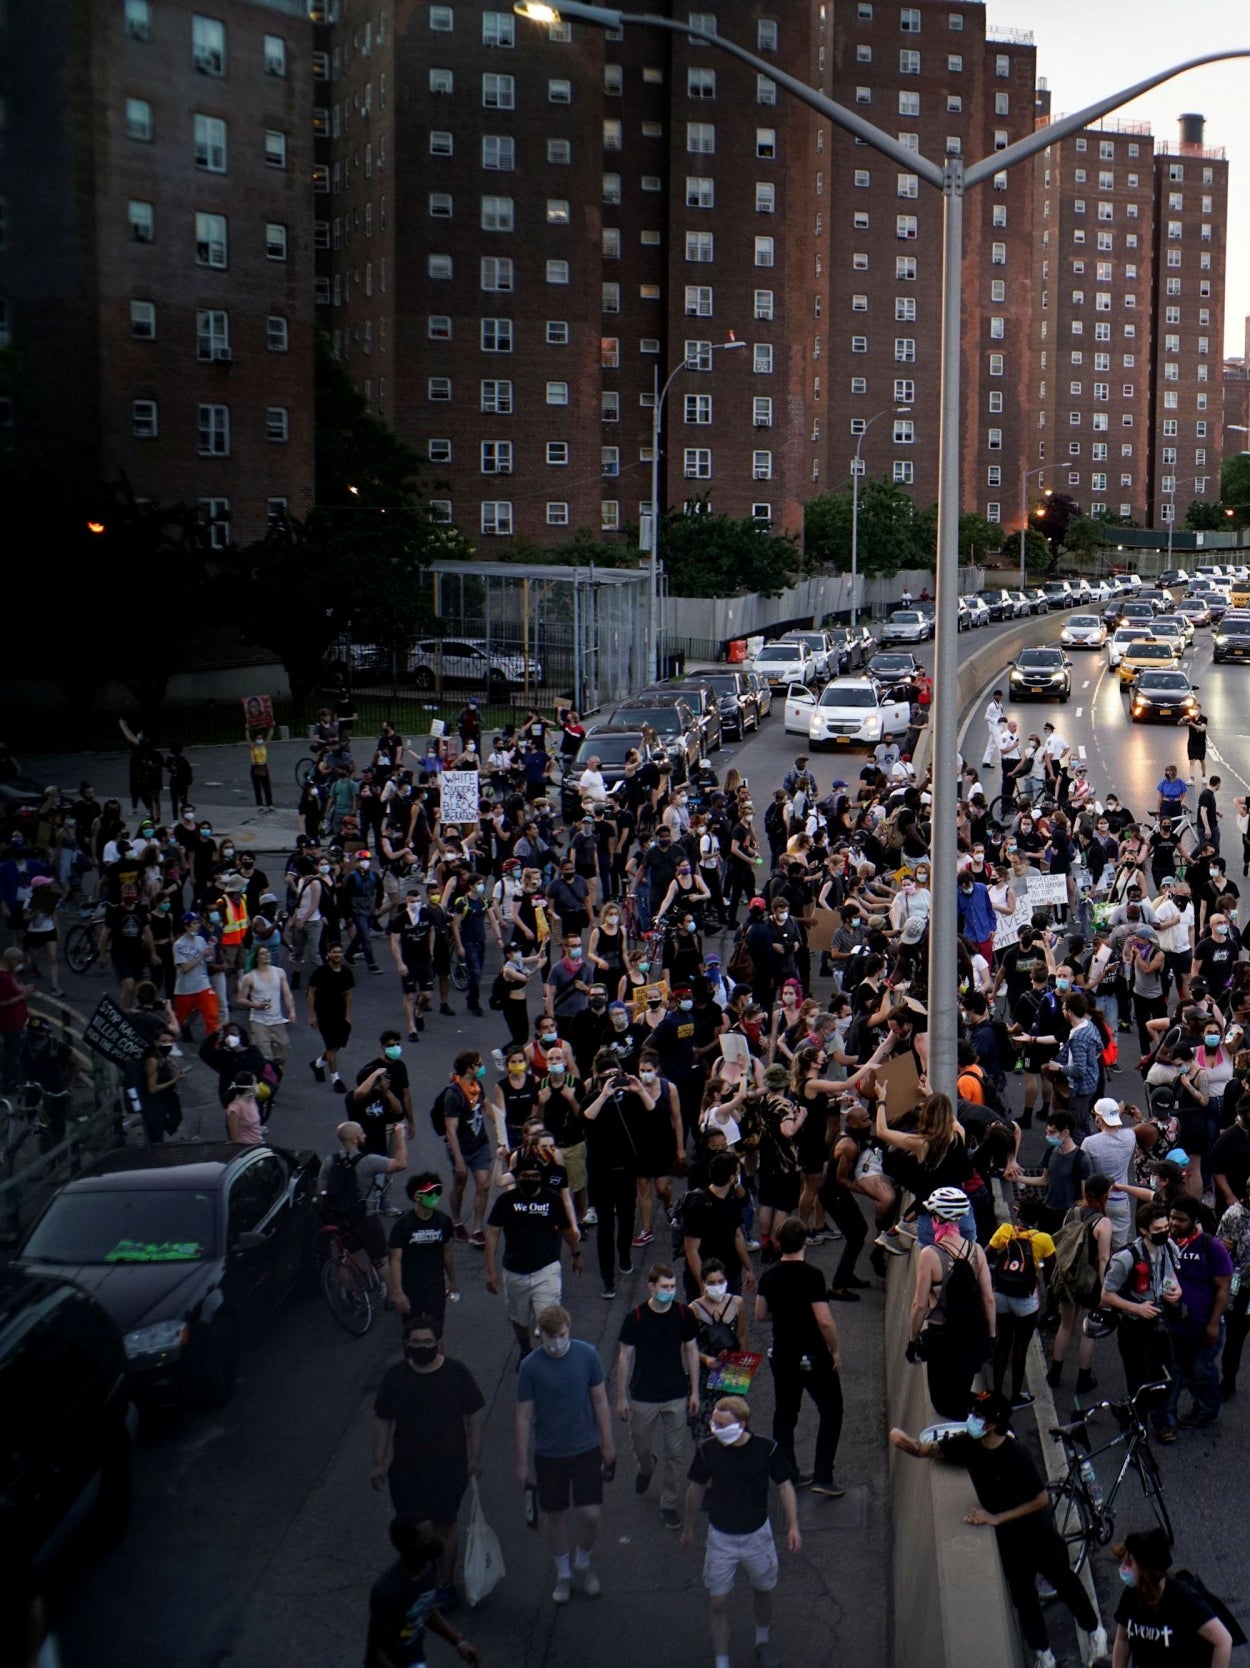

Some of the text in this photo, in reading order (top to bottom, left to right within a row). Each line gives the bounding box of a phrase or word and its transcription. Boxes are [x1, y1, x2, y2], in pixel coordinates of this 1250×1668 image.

[443, 772, 477, 784] WHITE
[443, 783, 477, 797] QUEERS
[442, 801, 477, 811] BLACK
[99, 1000, 122, 1024] STOP
[117, 1038, 144, 1059] COPS
[513, 1202, 549, 1212] We Out!
